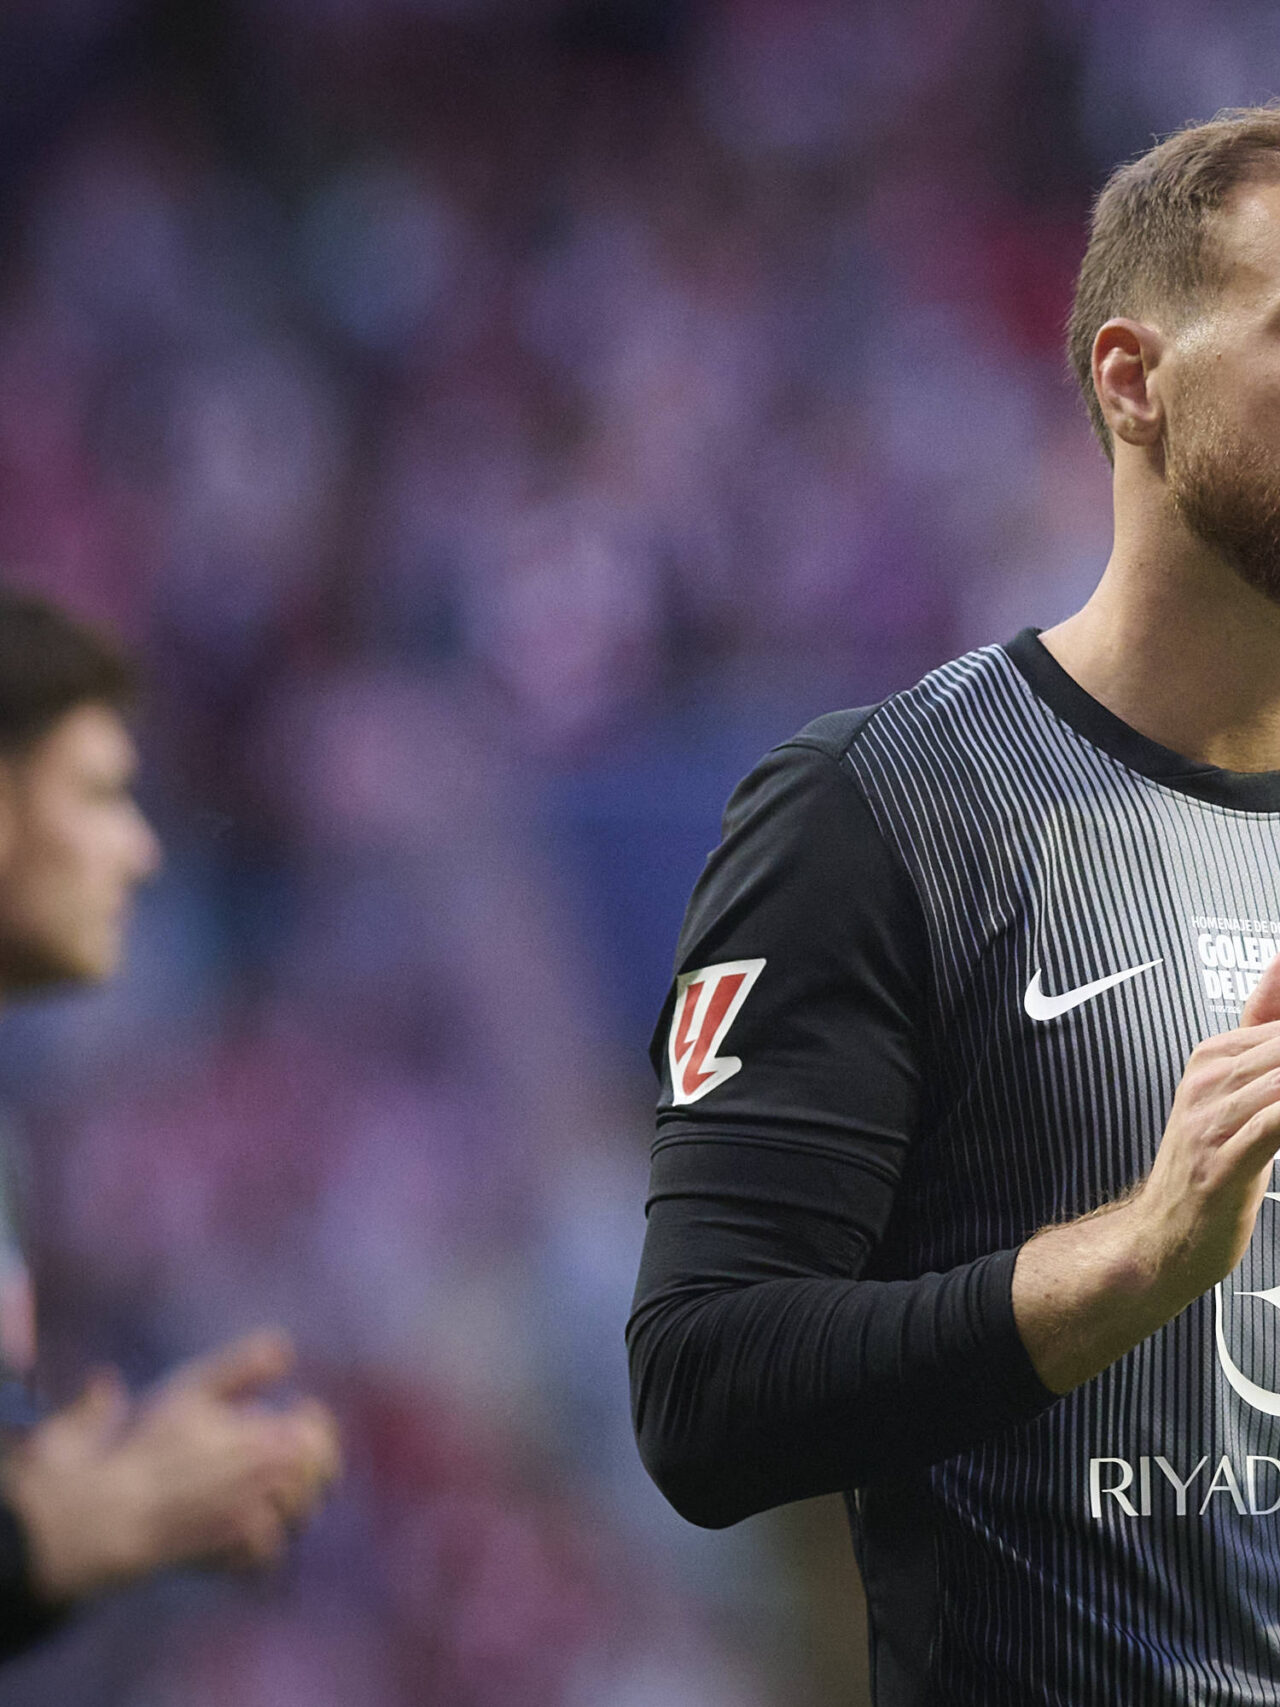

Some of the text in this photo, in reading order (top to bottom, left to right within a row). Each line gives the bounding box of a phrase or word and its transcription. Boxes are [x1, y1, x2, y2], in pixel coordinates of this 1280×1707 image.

[1191, 916, 1252, 933] HOMENAJE
[1253, 920, 1269, 934] DE
[1202, 969, 1236, 1001] DE
